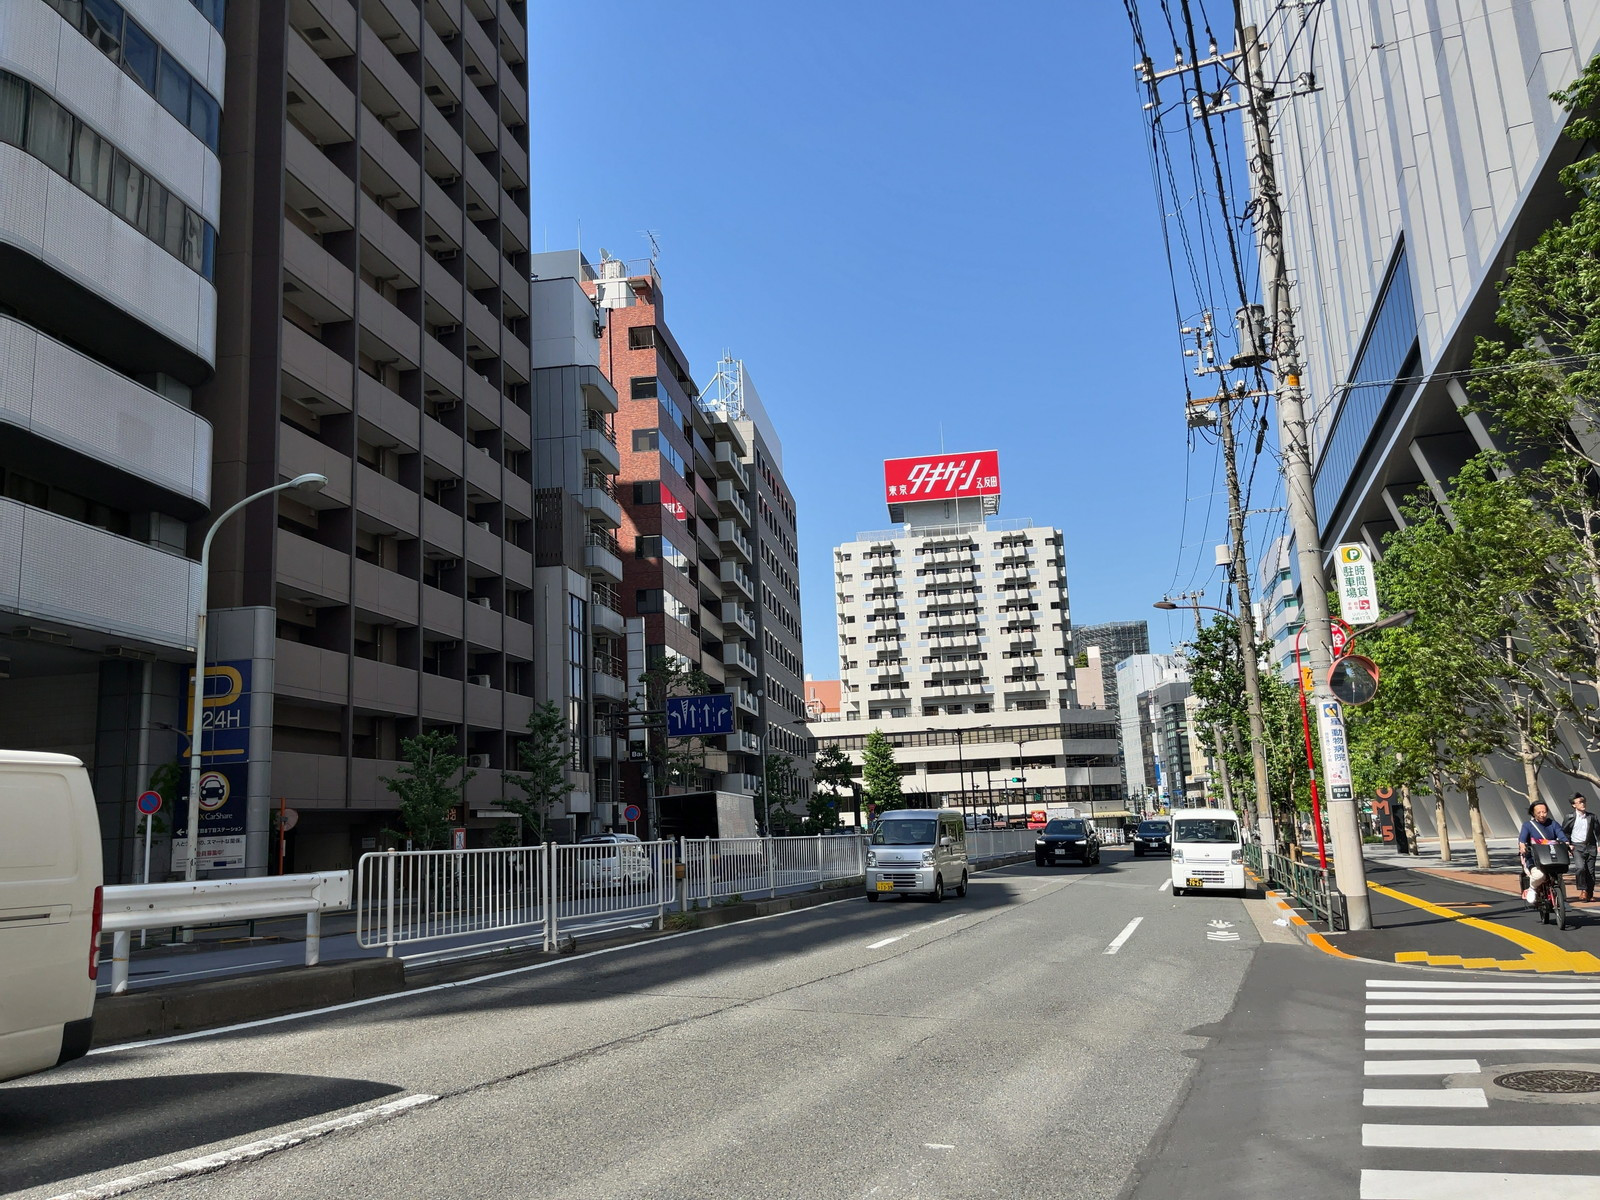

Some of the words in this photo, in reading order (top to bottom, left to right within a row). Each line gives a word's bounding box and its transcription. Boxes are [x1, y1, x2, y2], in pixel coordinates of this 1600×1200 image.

[888, 484, 908, 497] 東京
[907, 459, 981, 494] タキゲン
[975, 475, 998, 489] 五反田
[1343, 565, 1357, 598] 駐車場
[1354, 564, 1368, 597] 時間貸
[202, 709, 240, 729] 24H
[204, 812, 233, 820] CarShare
